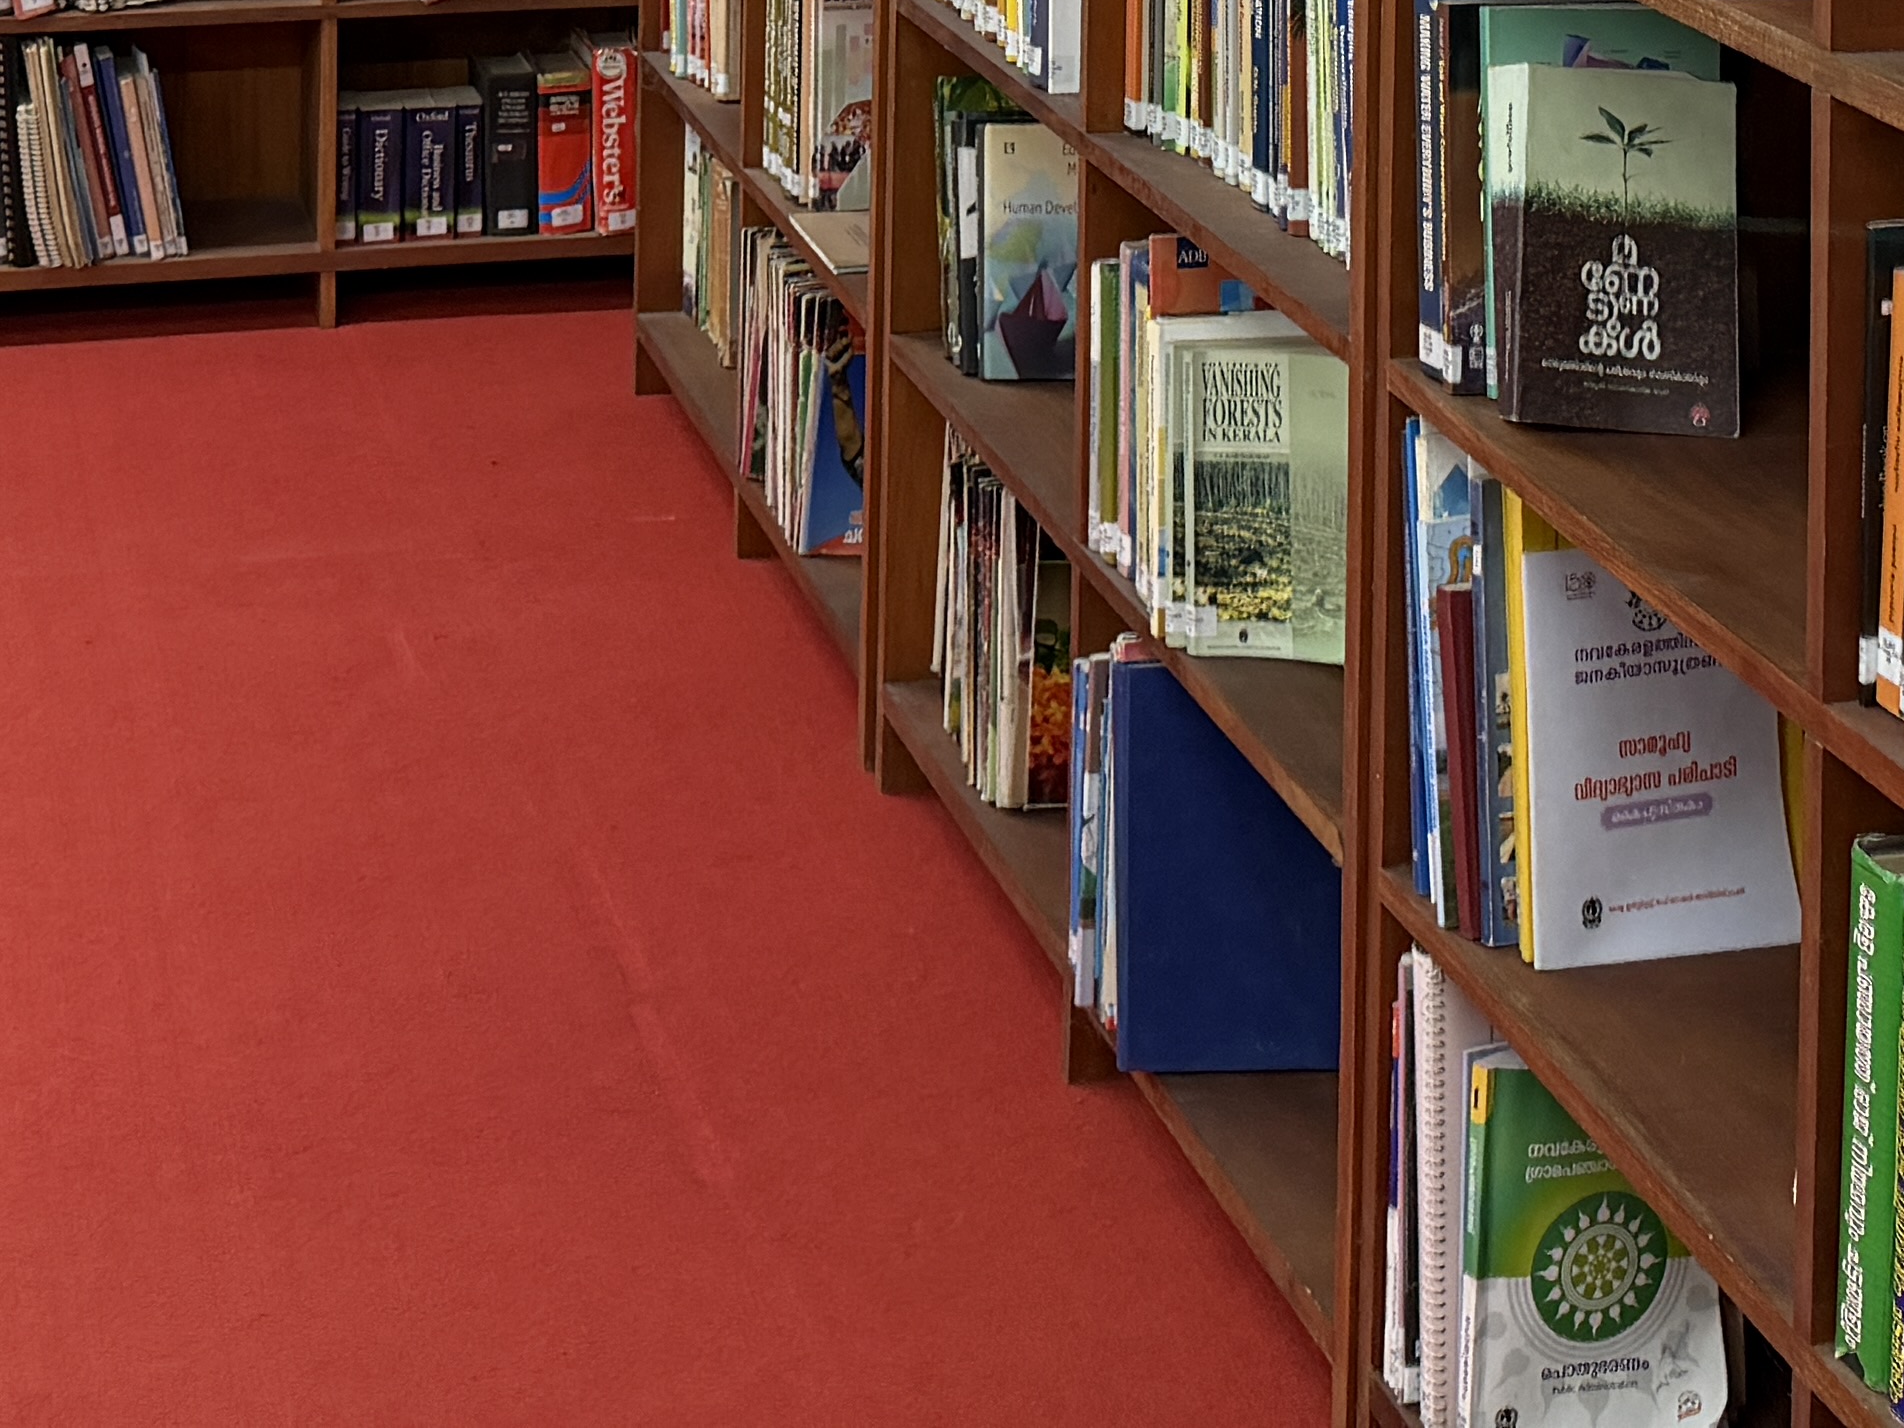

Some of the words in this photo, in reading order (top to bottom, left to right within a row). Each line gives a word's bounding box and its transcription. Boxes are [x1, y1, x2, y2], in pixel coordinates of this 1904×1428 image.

[1419, 14, 1432, 70] MAKING
[416, 110, 448, 122] Oxford
[1420, 75, 1433, 121] WATER
[420, 130, 432, 166] Office
[464, 122, 477, 182] Thesaurus
[602, 80, 626, 203] Webster's
[371, 128, 388, 201] Dictionary
[432, 144, 444, 189] Business
[432, 192, 443, 211] and
[1003, 201, 1042, 214] Human
[1422, 221, 1434, 291] BUSINESS
[1202, 368, 1281, 398] VANISHING
[1202, 398, 1282, 429] FORESTS
[1202, 428, 1216, 442] IN
[1222, 428, 1280, 443] KERALA
[1575, 771, 1662, 801] വിദ്യാഭ്യാസ
[1668, 755, 1737, 787] പരിപാടി
[1853, 882, 1876, 956] കേരള
[1541, 1357, 1649, 1380] പൊതുഭരണം
